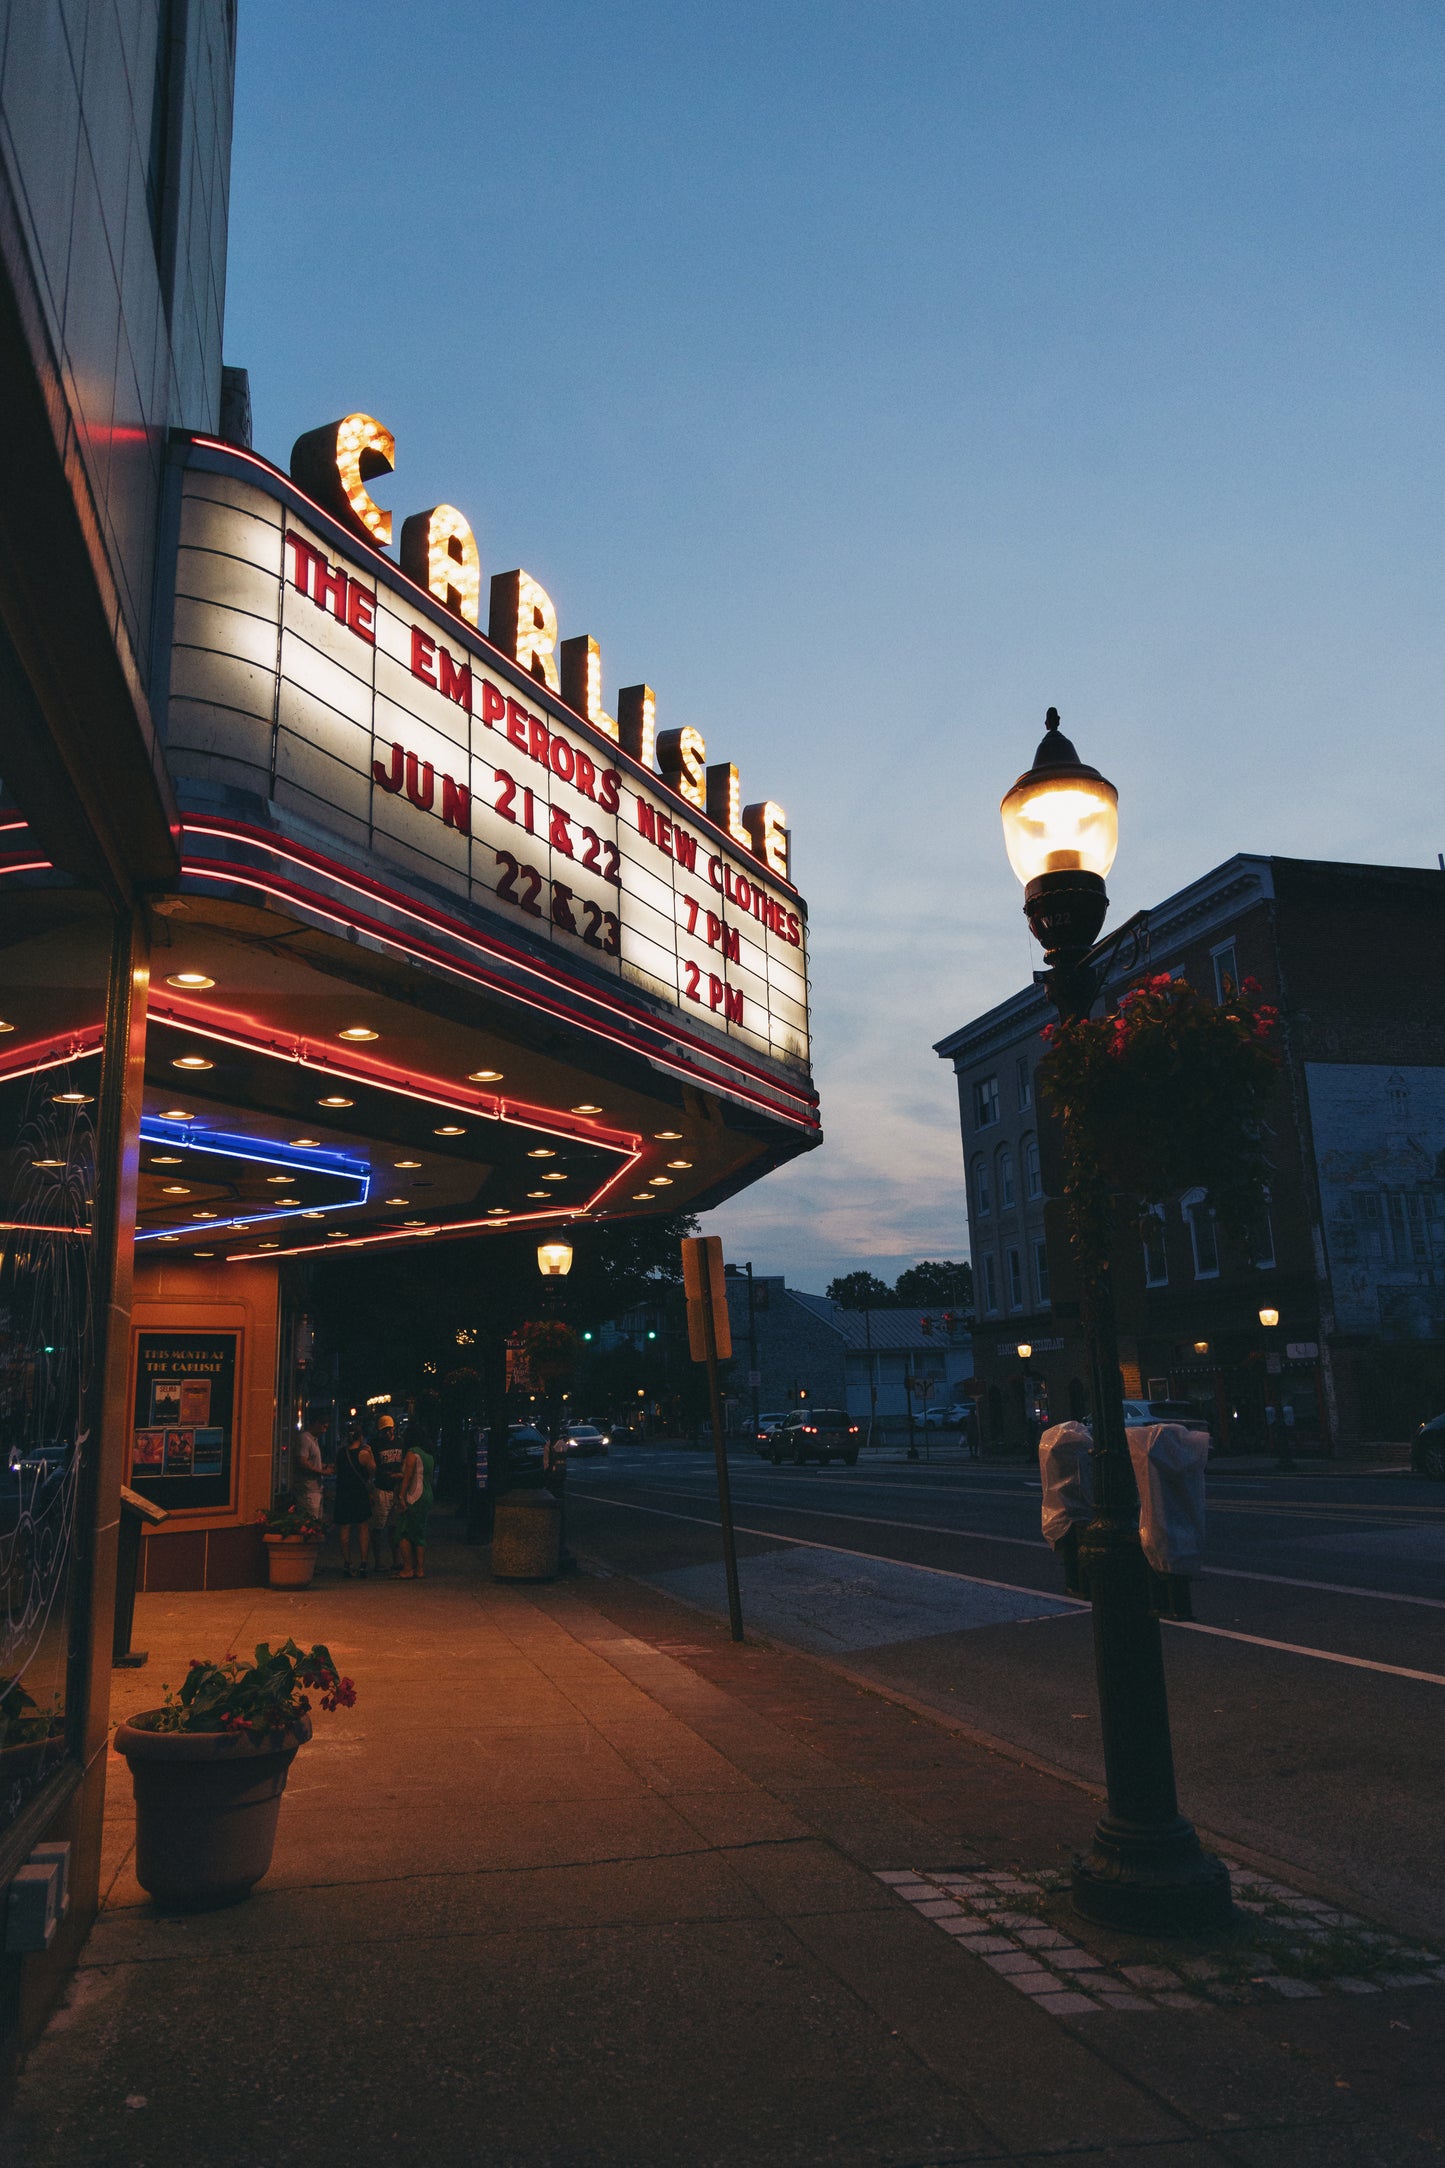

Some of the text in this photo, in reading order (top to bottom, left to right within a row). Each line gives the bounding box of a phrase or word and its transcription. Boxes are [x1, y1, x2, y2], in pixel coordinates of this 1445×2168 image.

[285, 529, 801, 948] THE EMPERORS NEW CLOTHES
[291, 412, 790, 881] CARLISLE
[373, 742, 740, 965] JUN 21 & 22 7 PM
[495, 851, 743, 1026] 22 & 23 2 PM
[145, 1350, 224, 1360] THIS MONTH AT
[145, 1363, 223, 1372] THE CARLISLE
